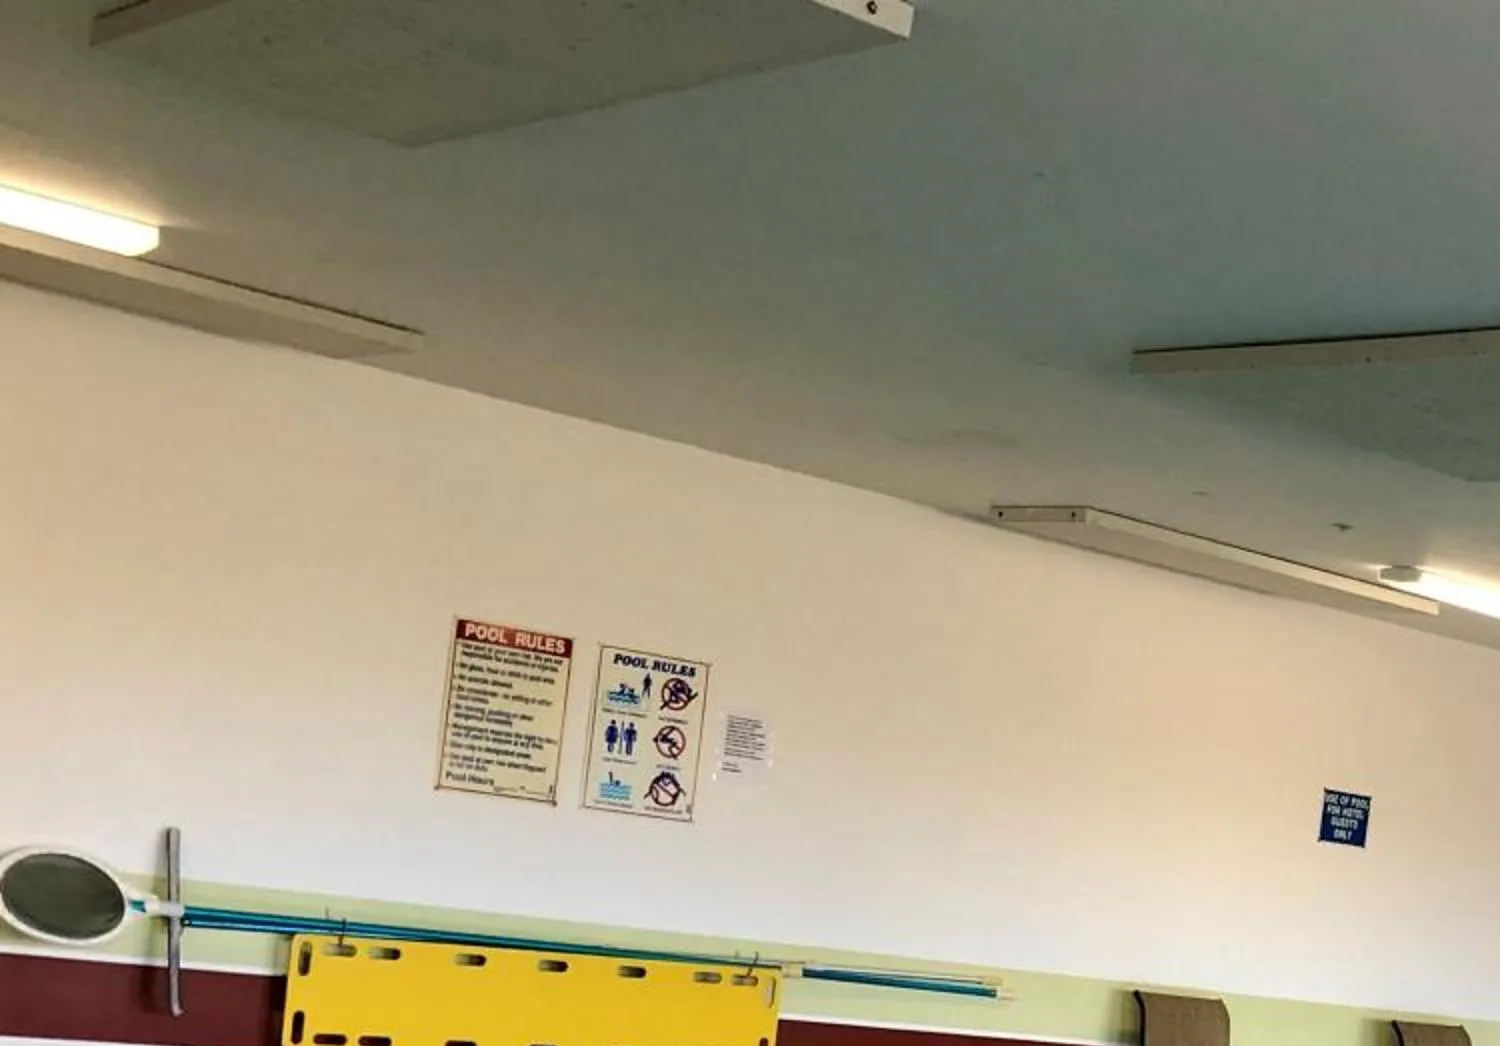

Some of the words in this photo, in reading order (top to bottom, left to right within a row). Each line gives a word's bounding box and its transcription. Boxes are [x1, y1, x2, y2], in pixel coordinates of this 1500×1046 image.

[465, 623, 508, 643] POOL
[515, 632, 565, 654] RULES
[613, 653, 650, 670] POOL
[651, 660, 697, 678] RULES
